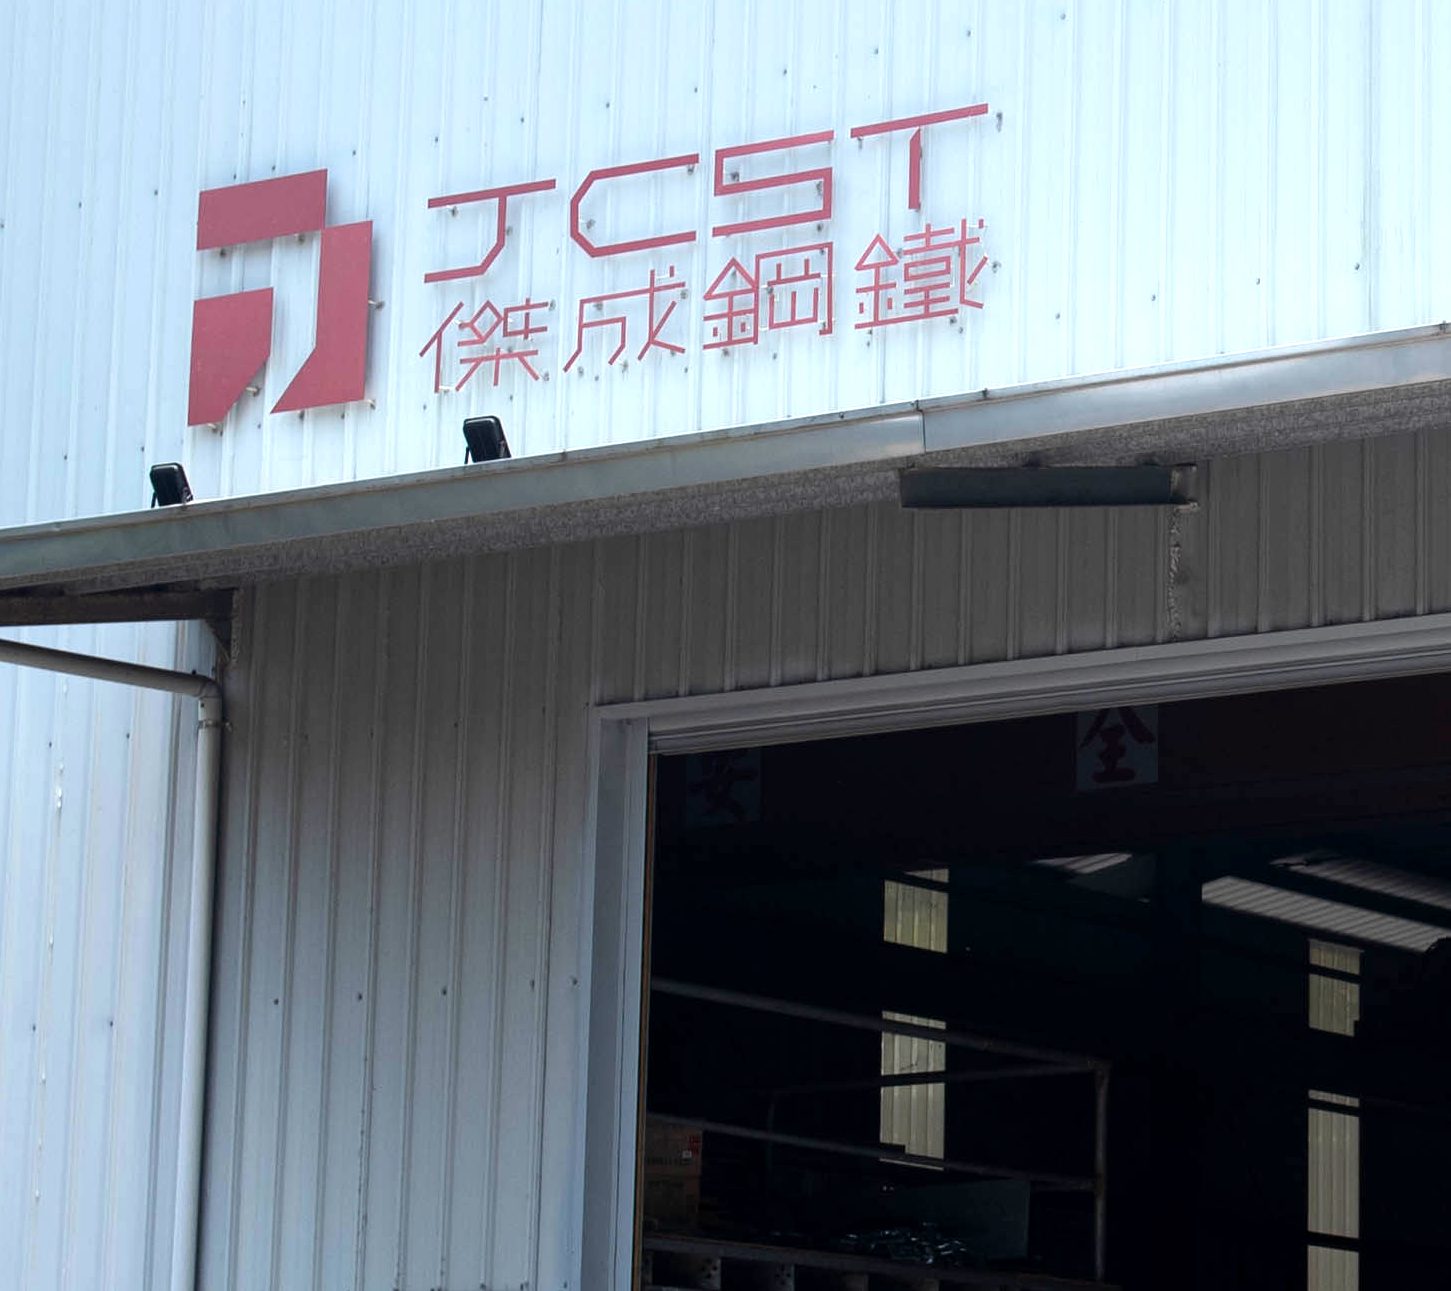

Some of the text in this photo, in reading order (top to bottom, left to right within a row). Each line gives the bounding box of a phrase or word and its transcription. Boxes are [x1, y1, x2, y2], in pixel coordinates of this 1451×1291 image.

[424, 104, 989, 284] JCST
[420, 218, 988, 393] 傑成鋼鐵
